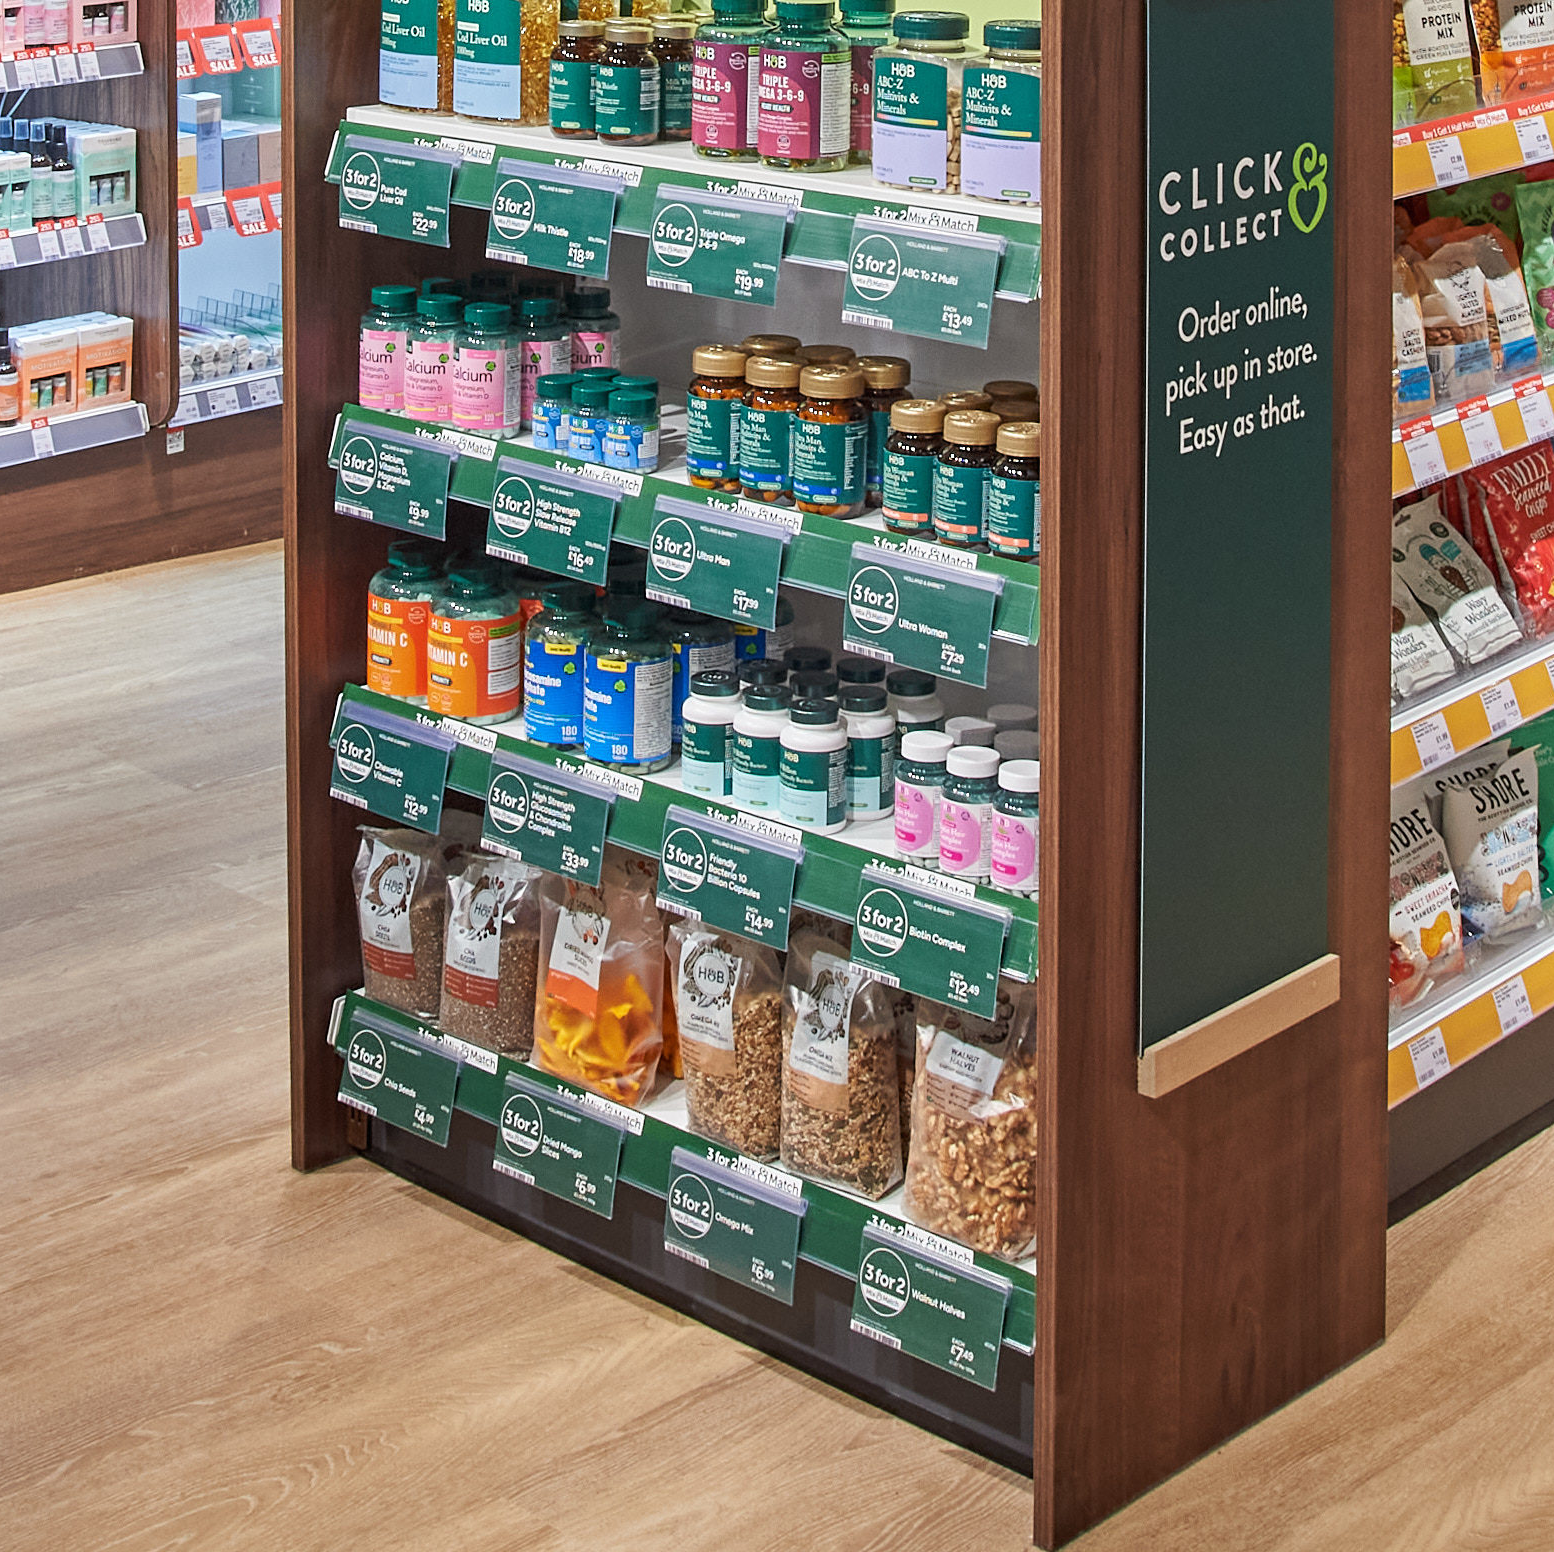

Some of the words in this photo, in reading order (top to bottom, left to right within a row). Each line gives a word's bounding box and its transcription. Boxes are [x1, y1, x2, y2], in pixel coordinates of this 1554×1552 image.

[1514, 0, 1553, 17] PROTEIN
[1528, 15, 1545, 28] MIX
[252, 54, 278, 67] SALE
[1159, 150, 1283, 216] CLICK
[1160, 208, 1282, 262] COLLECT
[855, 253, 864, 270] 3
[865, 255, 884, 273] for
[885, 258, 896, 276] 2
[902, 266, 919, 278] ABC
[921, 268, 930, 280] To
[931, 270, 938, 280] Z
[939, 271, 958, 286] Multi
[942, 312, 972, 329] £13.49
[1178, 300, 1240, 342] Order
[1246, 286, 1307, 327] online,
[1166, 360, 1207, 417] pick
[1214, 361, 1237, 400] up
[1244, 349, 1261, 381] in
[1267, 342, 1317, 375] store.
[1180, 417, 1227, 458] Easy
[1233, 413, 1254, 438] as
[1260, 394, 1305, 430] that.
[899, 618, 917, 631] Ultra
[919, 622, 948, 640] Woman
[941, 650, 964, 665] £7.29
[1476, 768, 1530, 814] SHORE
[909, 925, 930, 940] Biotin
[932, 932, 966, 954] Complex
[949, 980, 980, 997] £12.49
[912, 1288, 937, 1307] Walnut
[939, 1299, 965, 1319] Halves
[950, 1344, 974, 1363] £7.49
